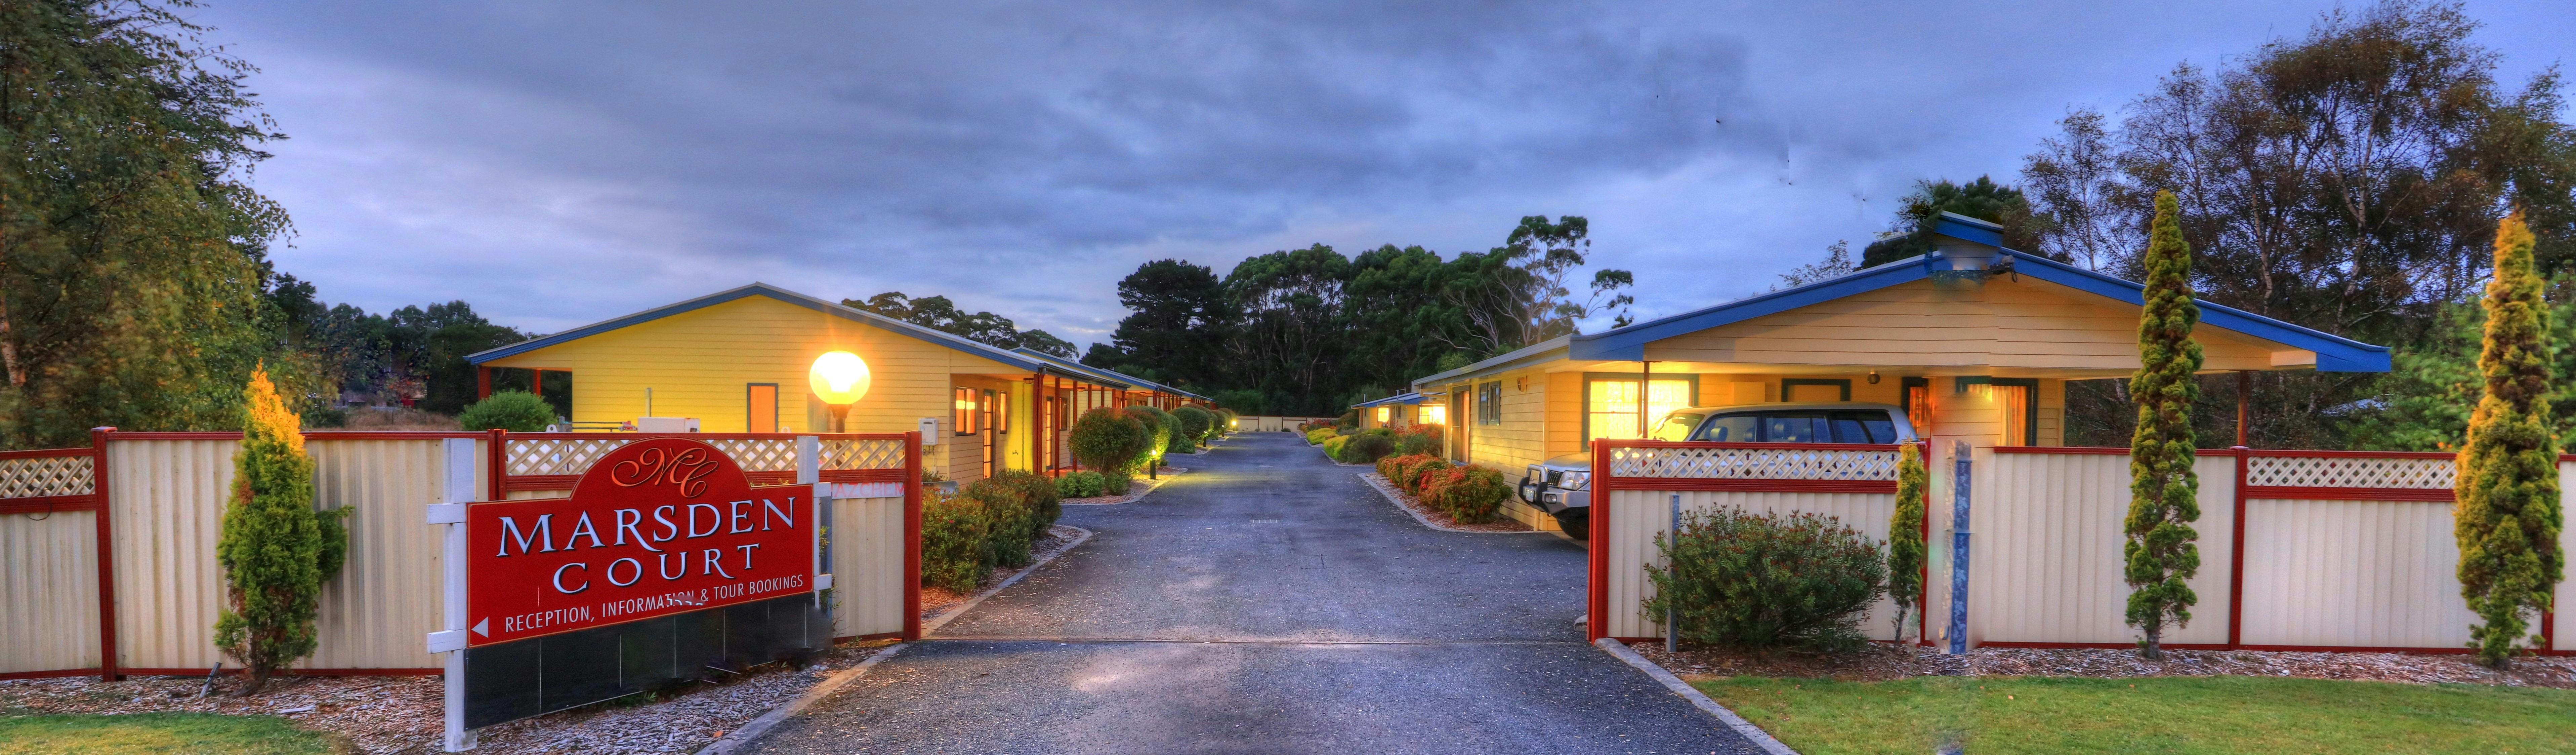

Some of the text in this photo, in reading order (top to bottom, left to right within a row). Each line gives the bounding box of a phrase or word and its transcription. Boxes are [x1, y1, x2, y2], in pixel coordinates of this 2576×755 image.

[831, 482, 905, 498] AZCHEM
[496, 497, 796, 557] MARSDEN
[553, 543, 761, 594] COURT
[505, 605, 595, 633] RECEPTION,
[701, 589, 709, 602] &
[713, 583, 744, 600] TOUR
[749, 574, 803, 595] BOOKINGS
